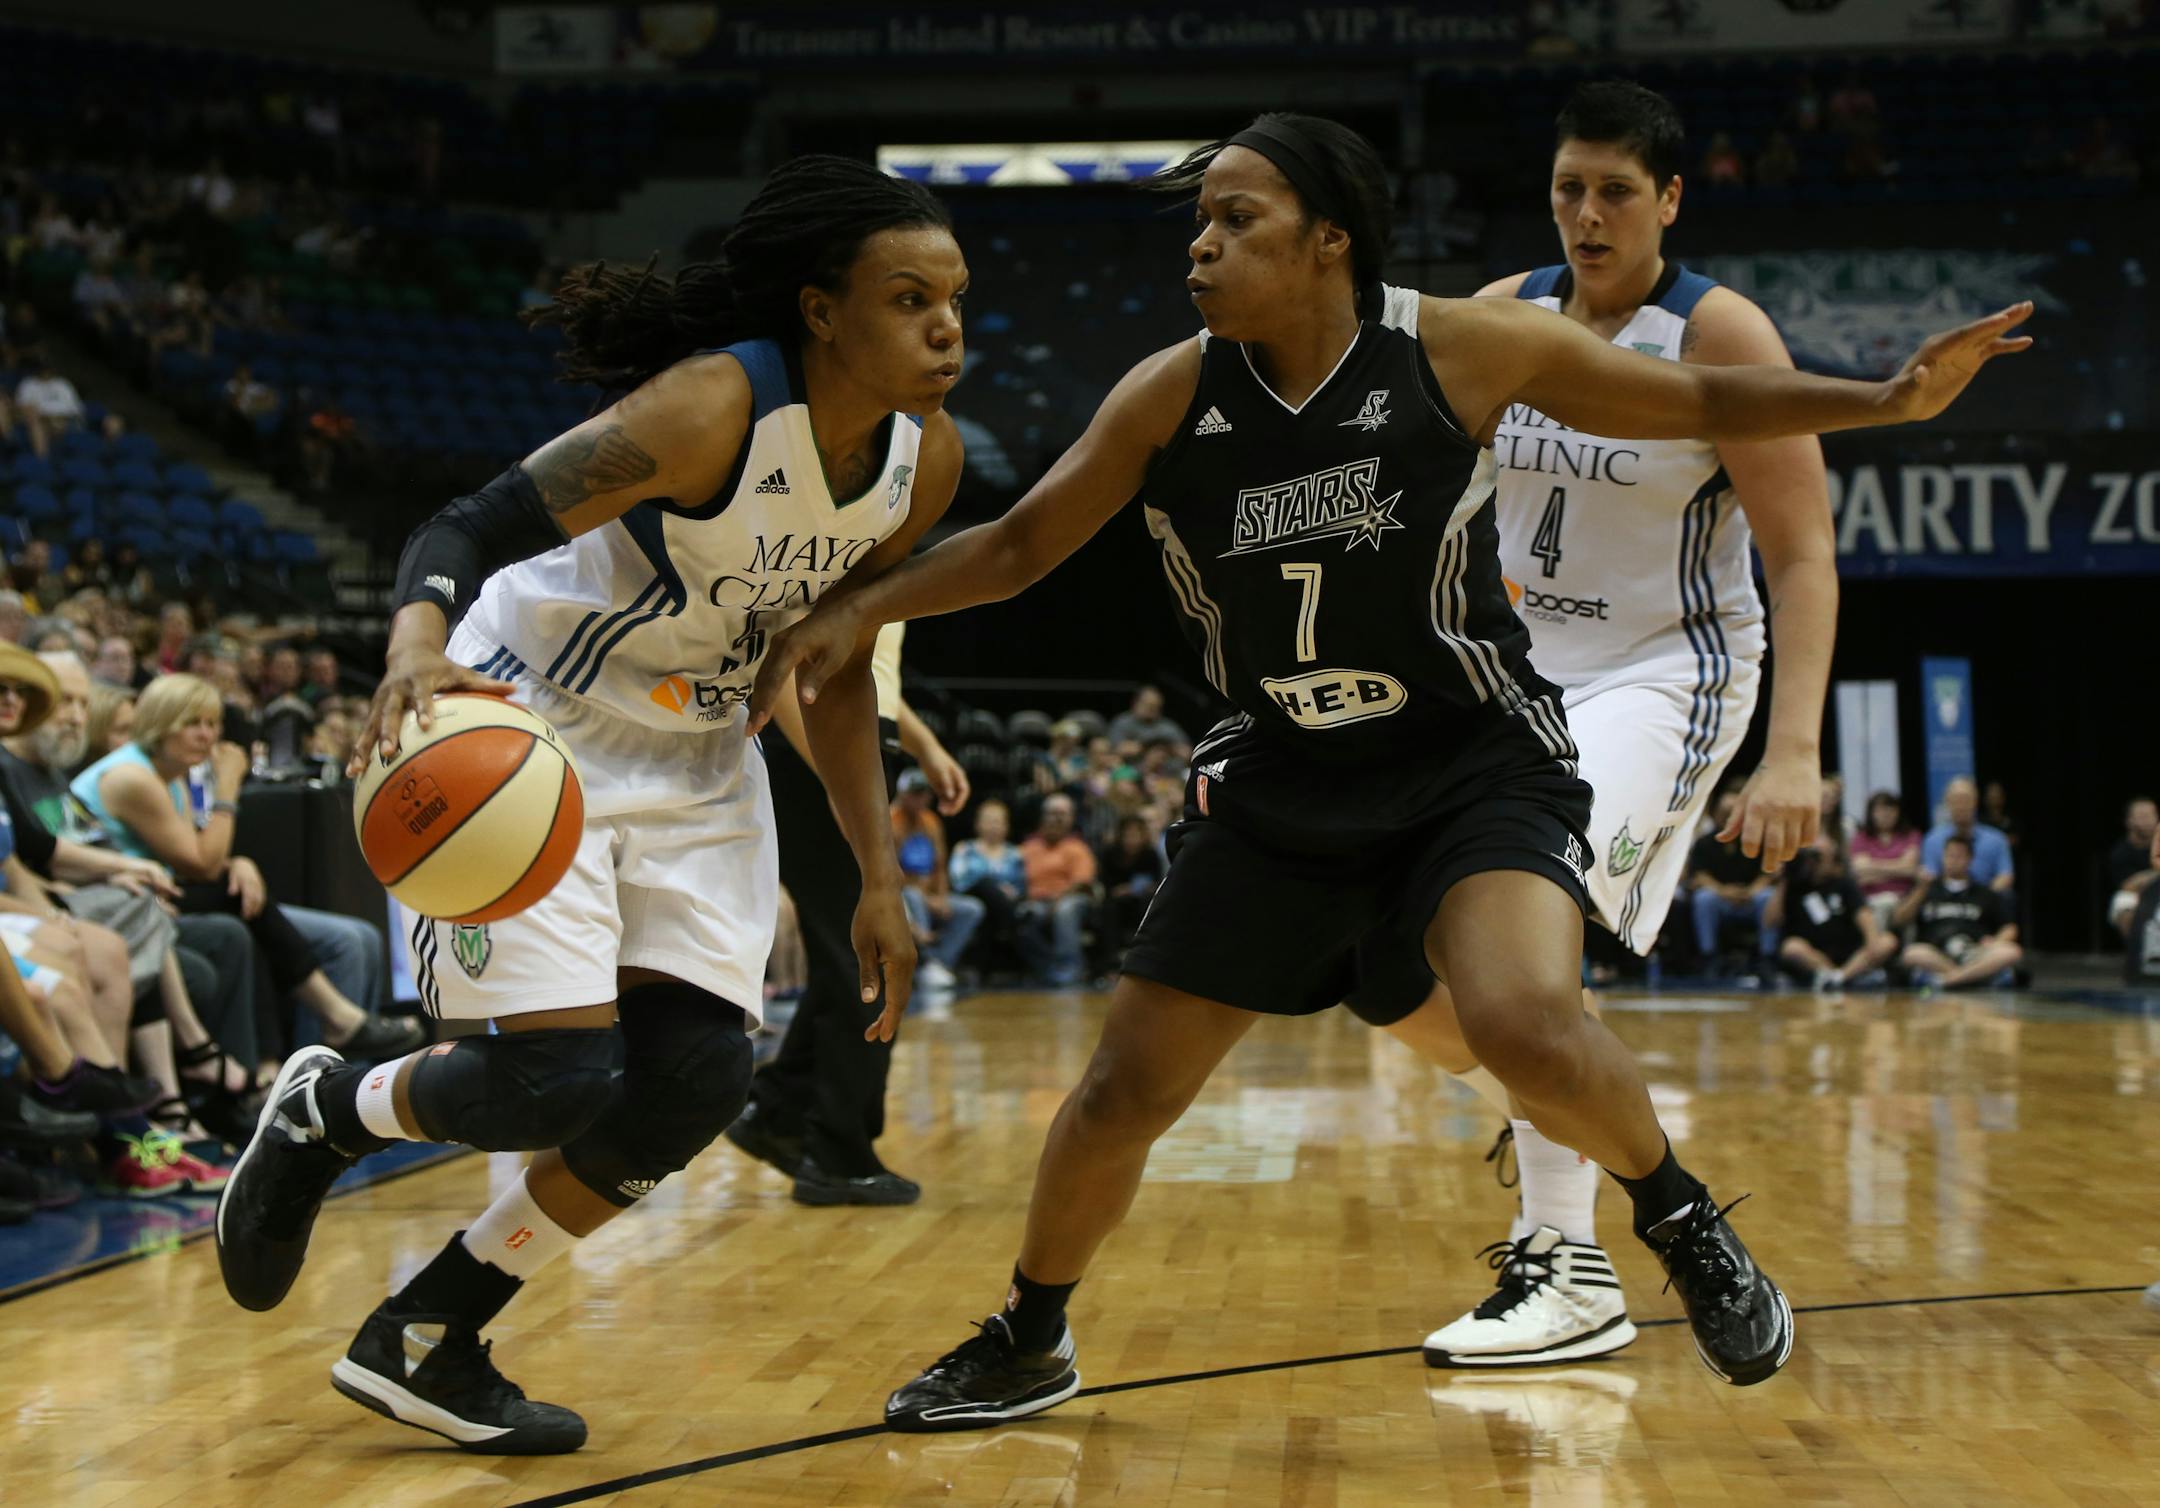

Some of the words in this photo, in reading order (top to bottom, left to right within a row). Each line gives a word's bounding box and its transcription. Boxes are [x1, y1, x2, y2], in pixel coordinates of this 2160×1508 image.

[1195, 421, 1233, 436] adidas
[755, 483, 790, 495] adidas
[1234, 457, 1380, 549] STARS
[1530, 486, 1566, 579] 4
[1280, 563, 1322, 663] 7
[1524, 585, 1609, 621] boost
